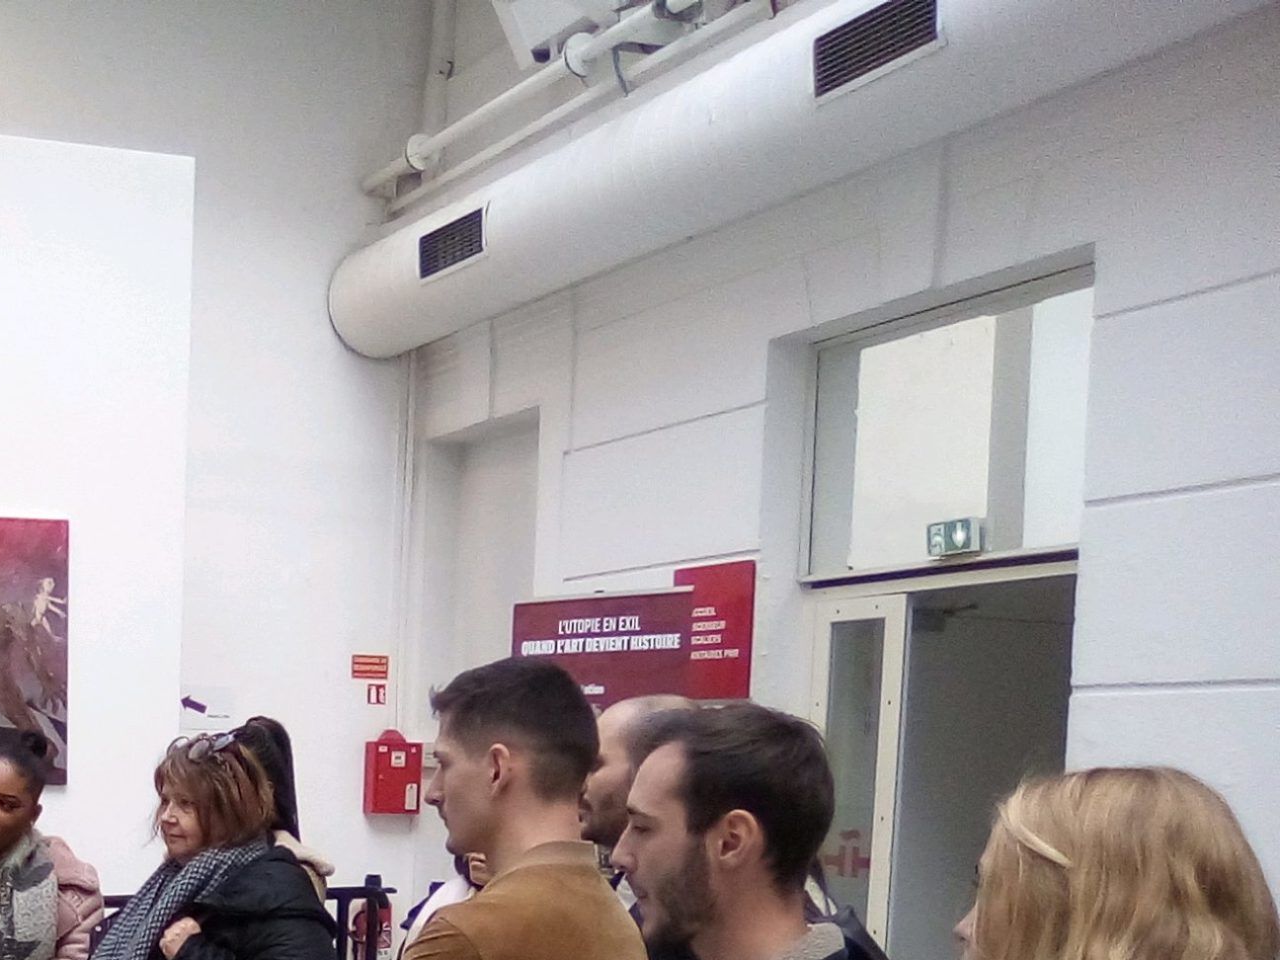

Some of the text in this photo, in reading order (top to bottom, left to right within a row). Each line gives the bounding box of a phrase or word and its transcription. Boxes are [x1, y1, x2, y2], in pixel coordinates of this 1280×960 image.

[558, 616, 641, 635] L'UTOPIE EN EXIL
[521, 639, 556, 656] QUAND
[556, 638, 585, 654] L'ART
[585, 636, 630, 652] DEVIENT
[630, 633, 681, 650] HISTOIRE
